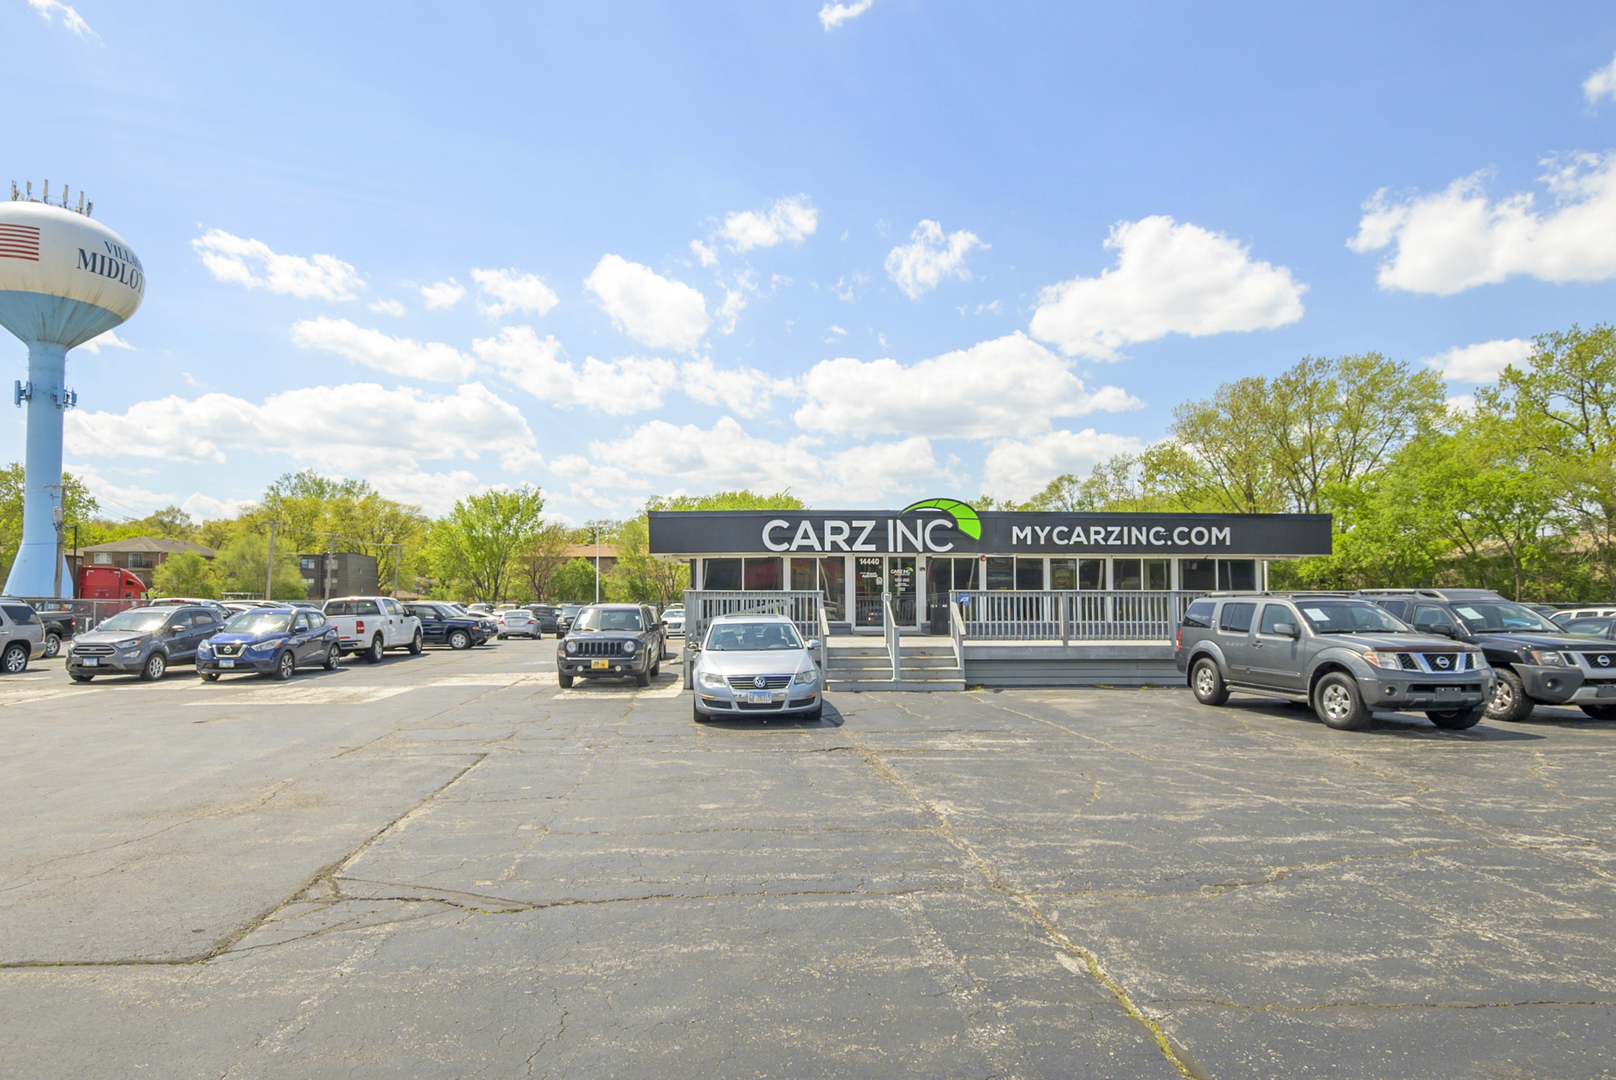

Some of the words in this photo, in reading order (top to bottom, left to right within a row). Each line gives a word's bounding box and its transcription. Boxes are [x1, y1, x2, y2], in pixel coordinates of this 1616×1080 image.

[762, 519, 876, 551] CARZ
[888, 519, 954, 552] INC
[1012, 526, 1231, 546] MYCARZINC.COM
